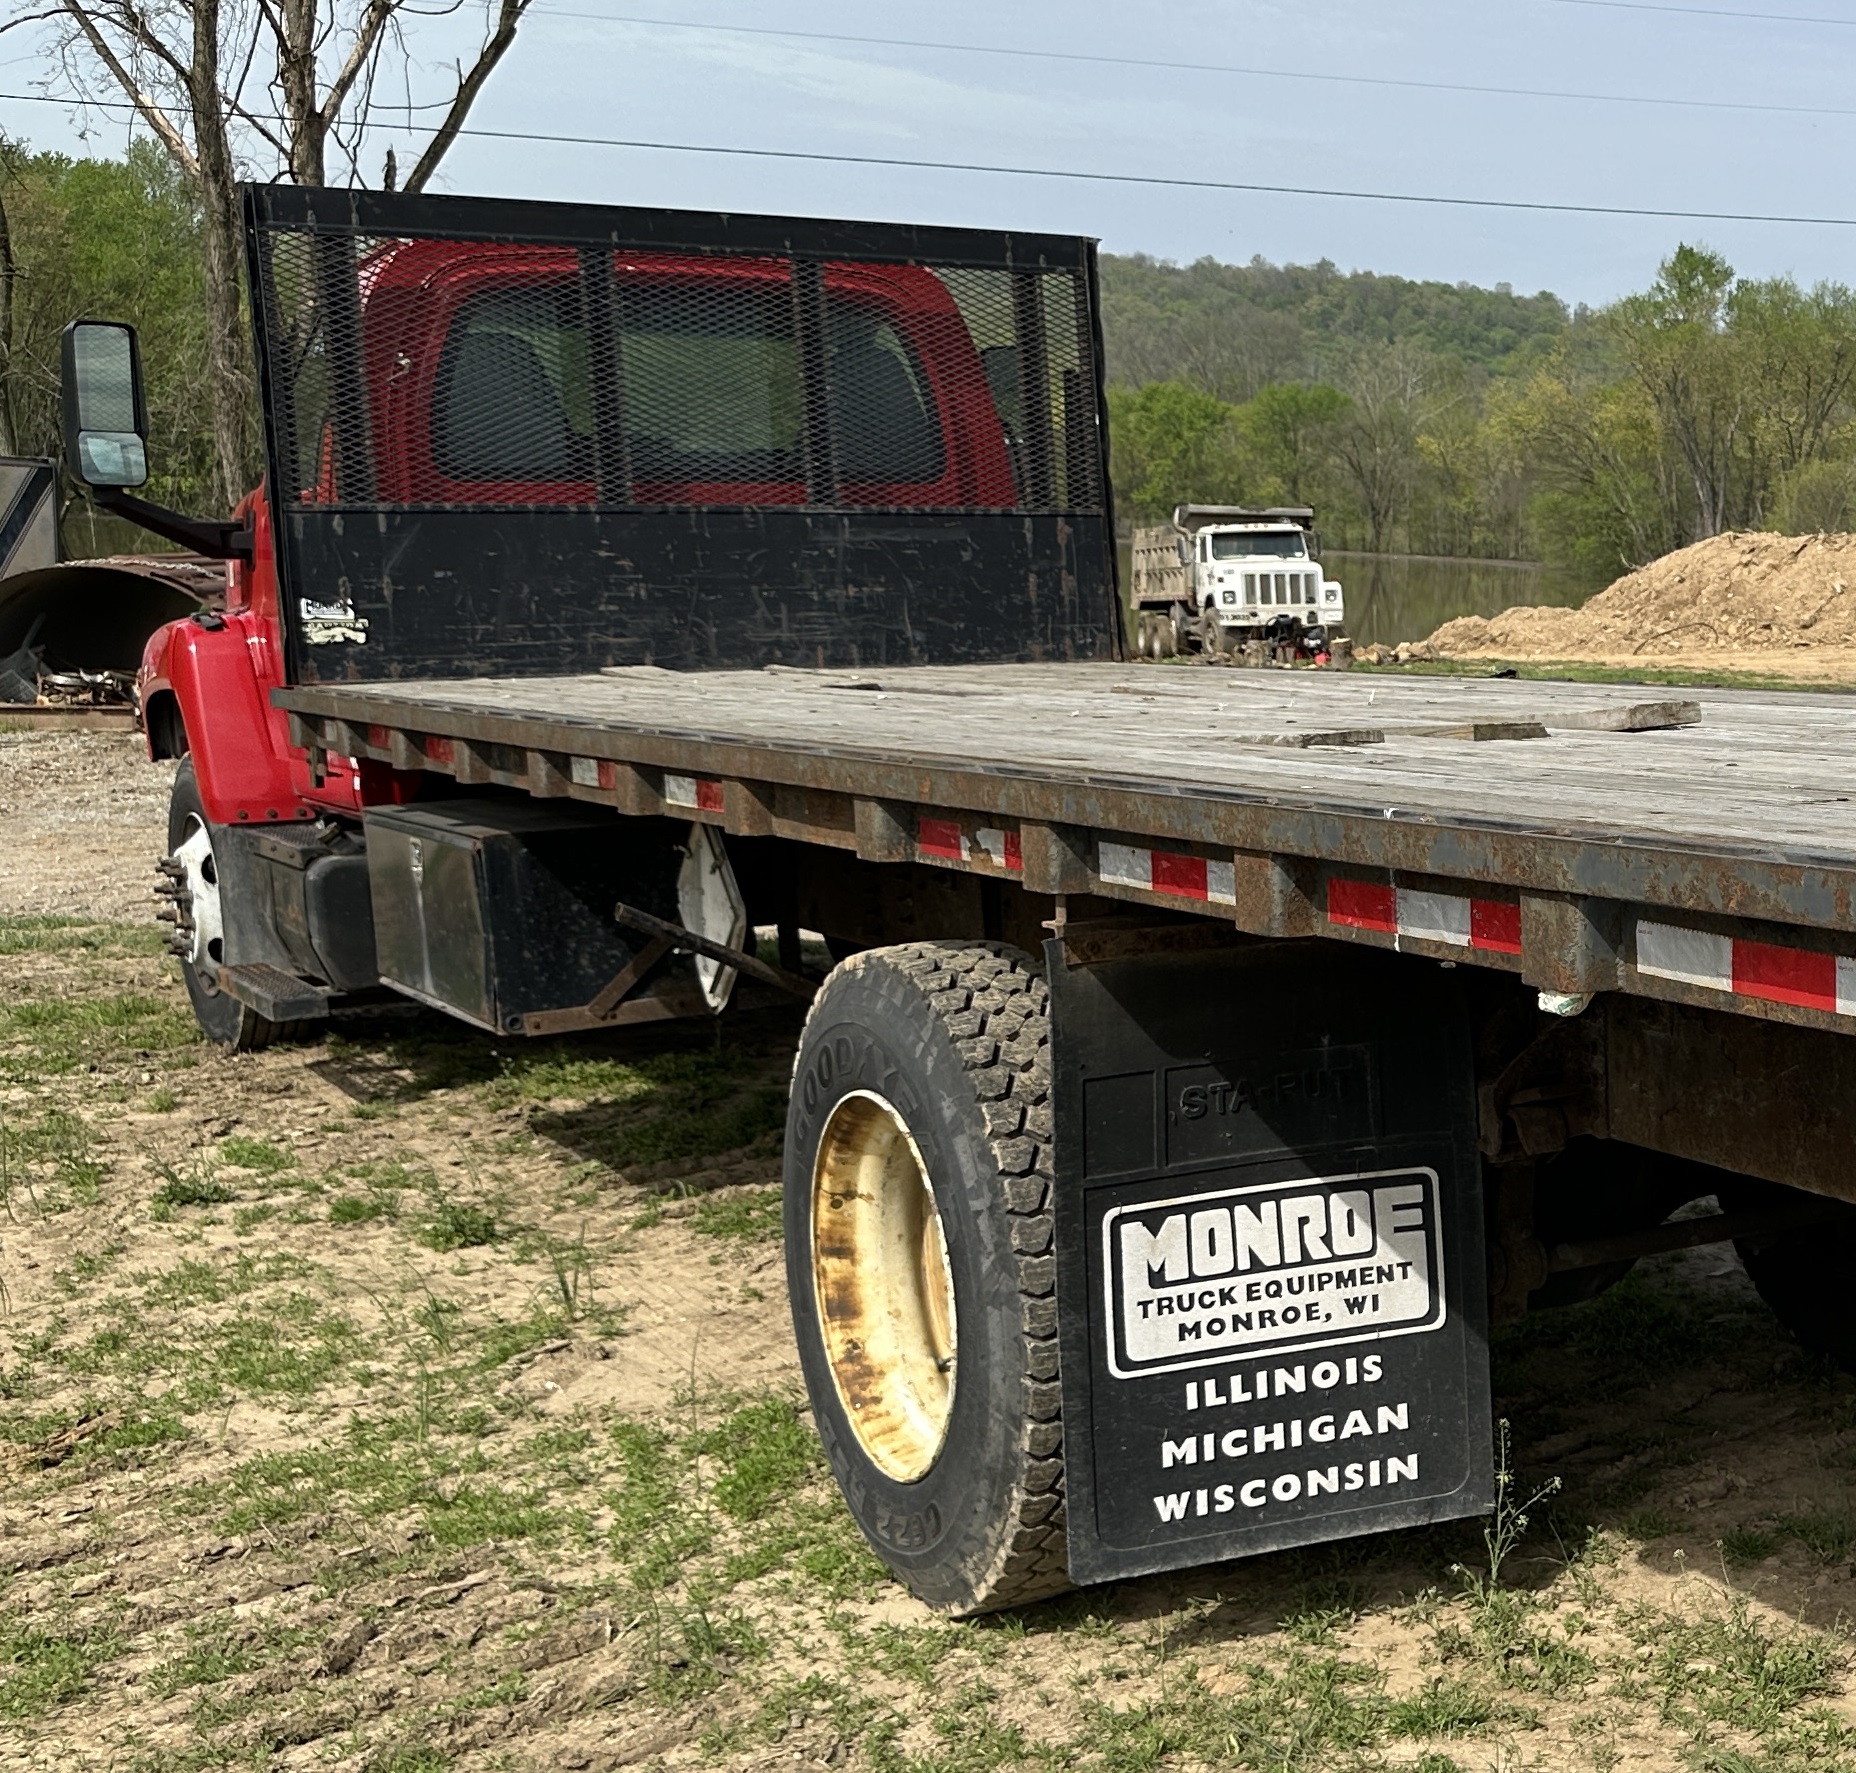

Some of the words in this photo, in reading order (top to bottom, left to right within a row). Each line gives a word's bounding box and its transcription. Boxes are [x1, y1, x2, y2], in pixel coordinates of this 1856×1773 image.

[1120, 1184, 1427, 1286] MONROE
[1136, 1285, 1239, 1320] TRUCK
[1246, 1260, 1414, 1302] EQUIPMENT
[1178, 1301, 1333, 1342] MONROE,
[1343, 1293, 1380, 1316] WI
[1185, 1354, 1383, 1411] ILLINOIS
[1161, 1402, 1409, 1469] MICHIGAN
[1153, 1453, 1419, 1523] WISCONSIN
